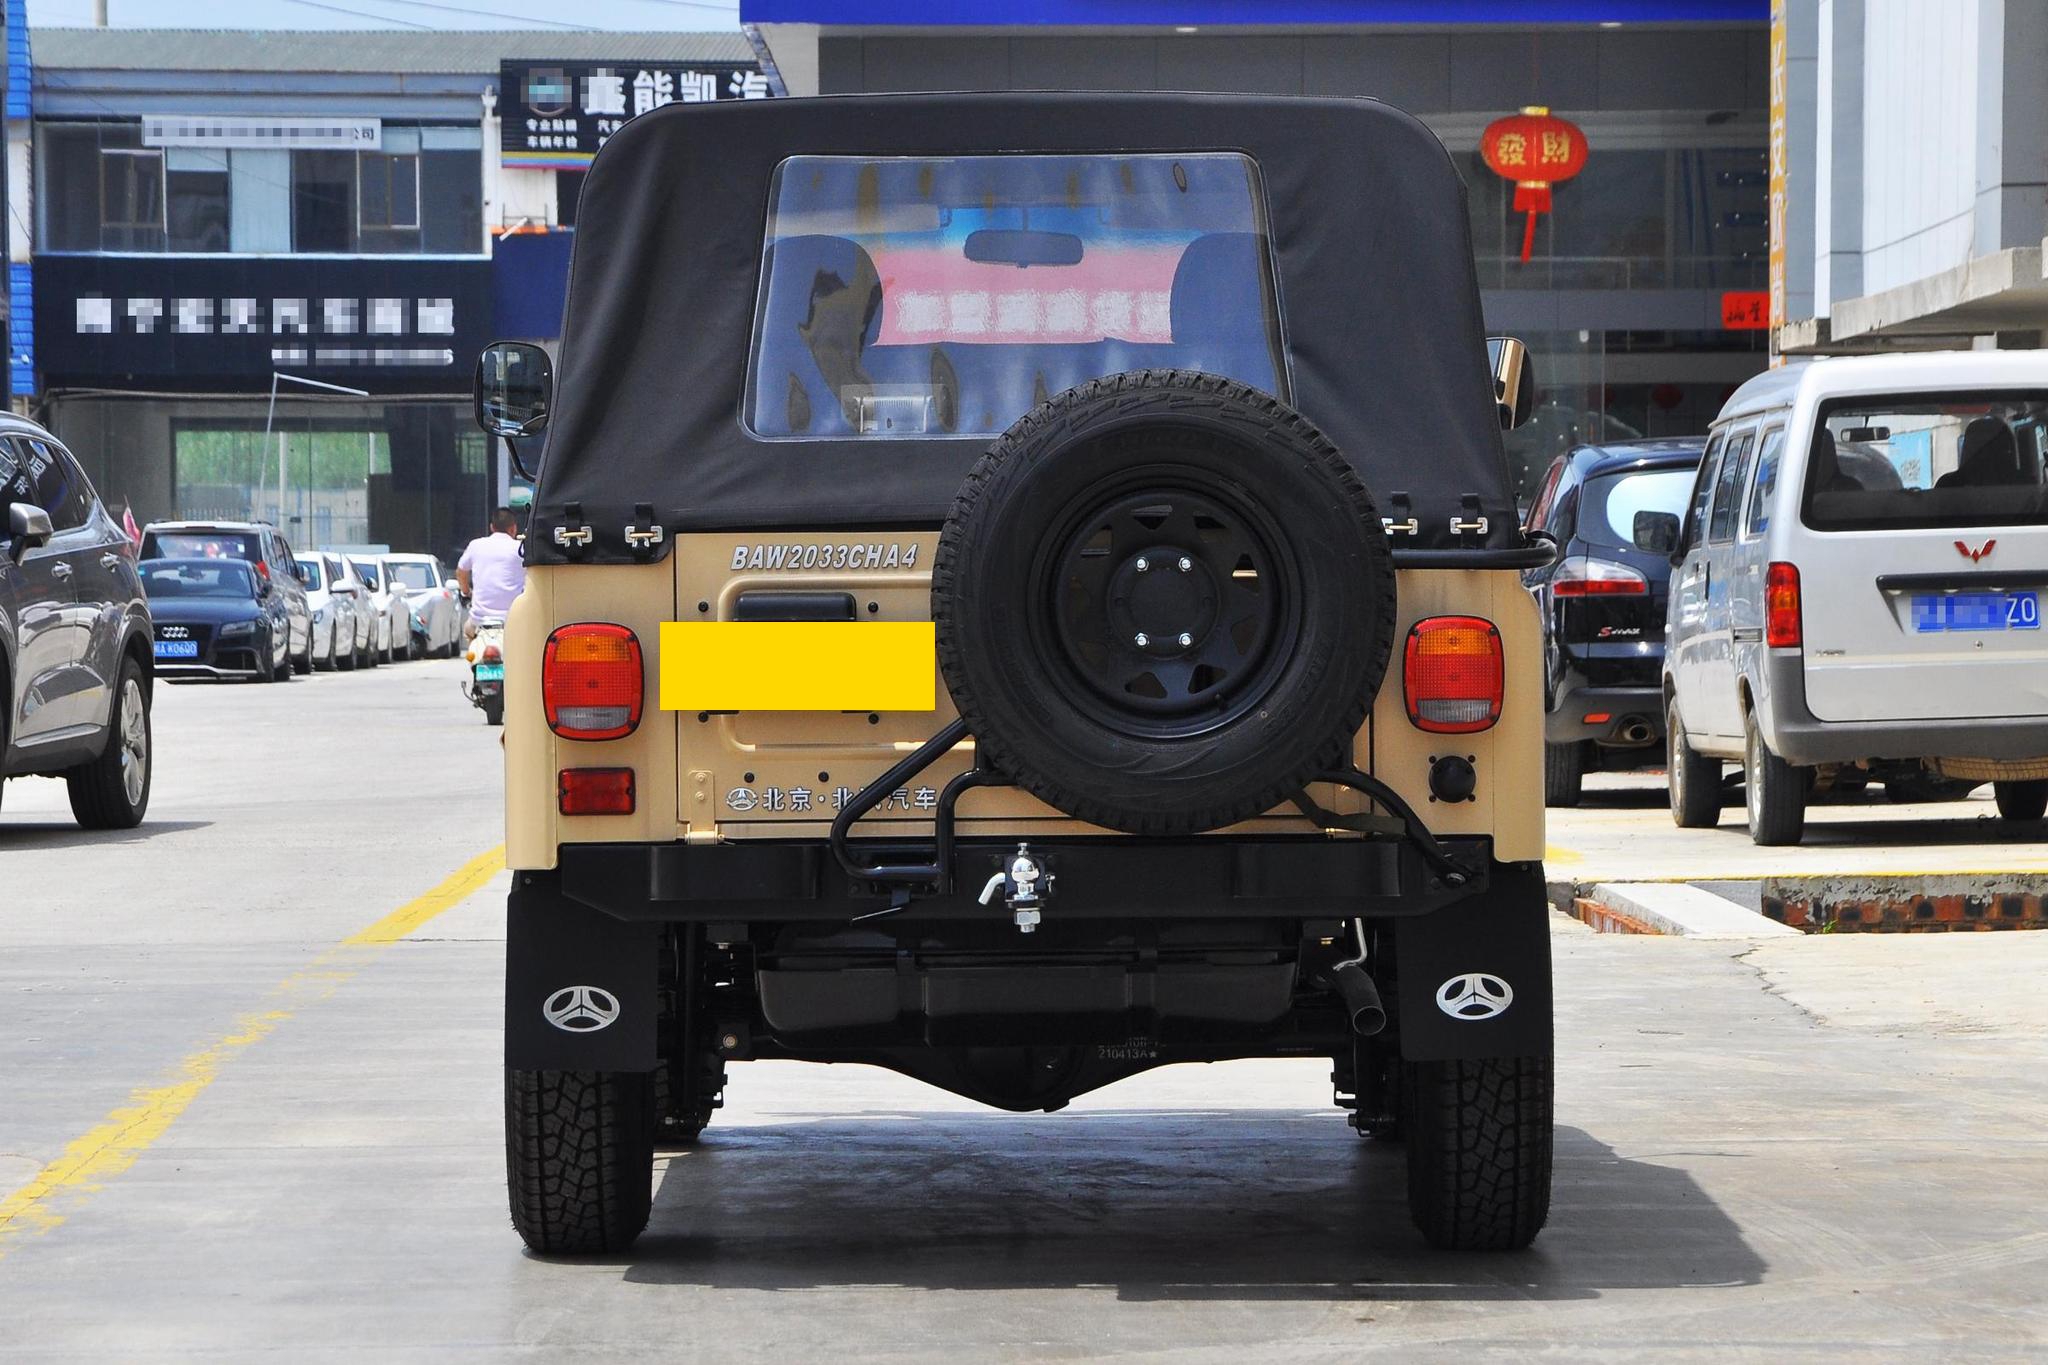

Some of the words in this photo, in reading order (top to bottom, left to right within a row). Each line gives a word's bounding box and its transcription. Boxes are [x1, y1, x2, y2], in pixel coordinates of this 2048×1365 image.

[731, 543, 918, 569] BAW2033CHA4
[762, 787, 937, 811] 北京·北汽车
